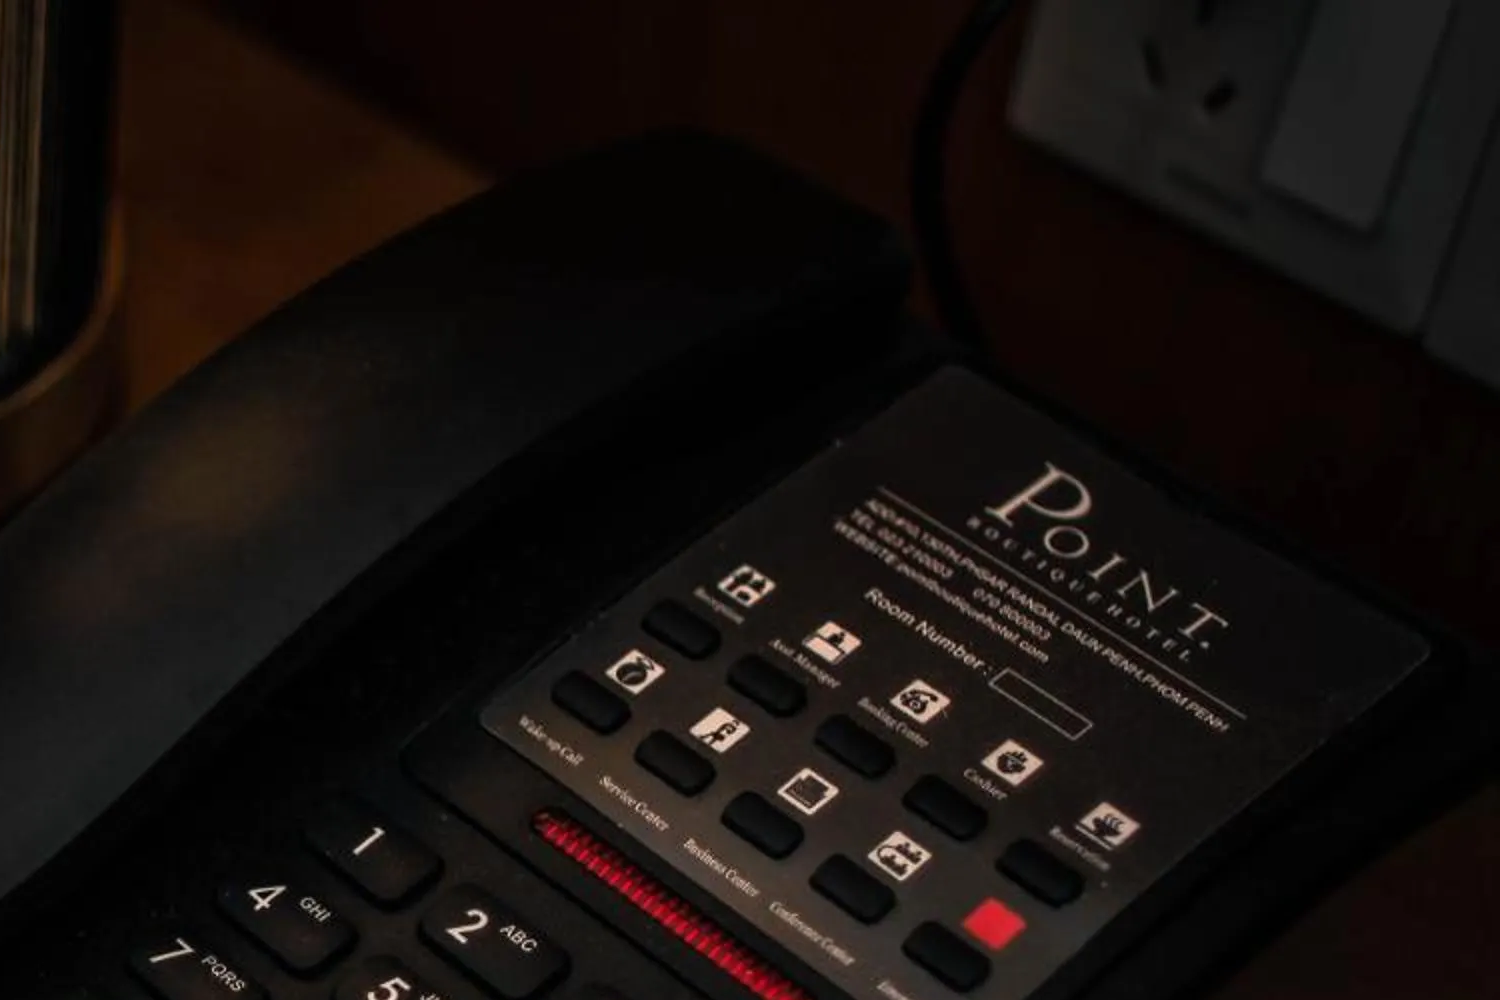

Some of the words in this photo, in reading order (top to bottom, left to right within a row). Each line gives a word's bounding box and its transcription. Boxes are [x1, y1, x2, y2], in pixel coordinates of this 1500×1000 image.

[863, 586, 917, 628] Room
[352, 826, 386, 856] 1
[247, 884, 288, 912] 4
[299, 895, 332, 923] GHI
[445, 907, 490, 945] 2
[499, 923, 539, 954] ABC
[148, 936, 196, 965] 7
[200, 953, 247, 993] PQRS
